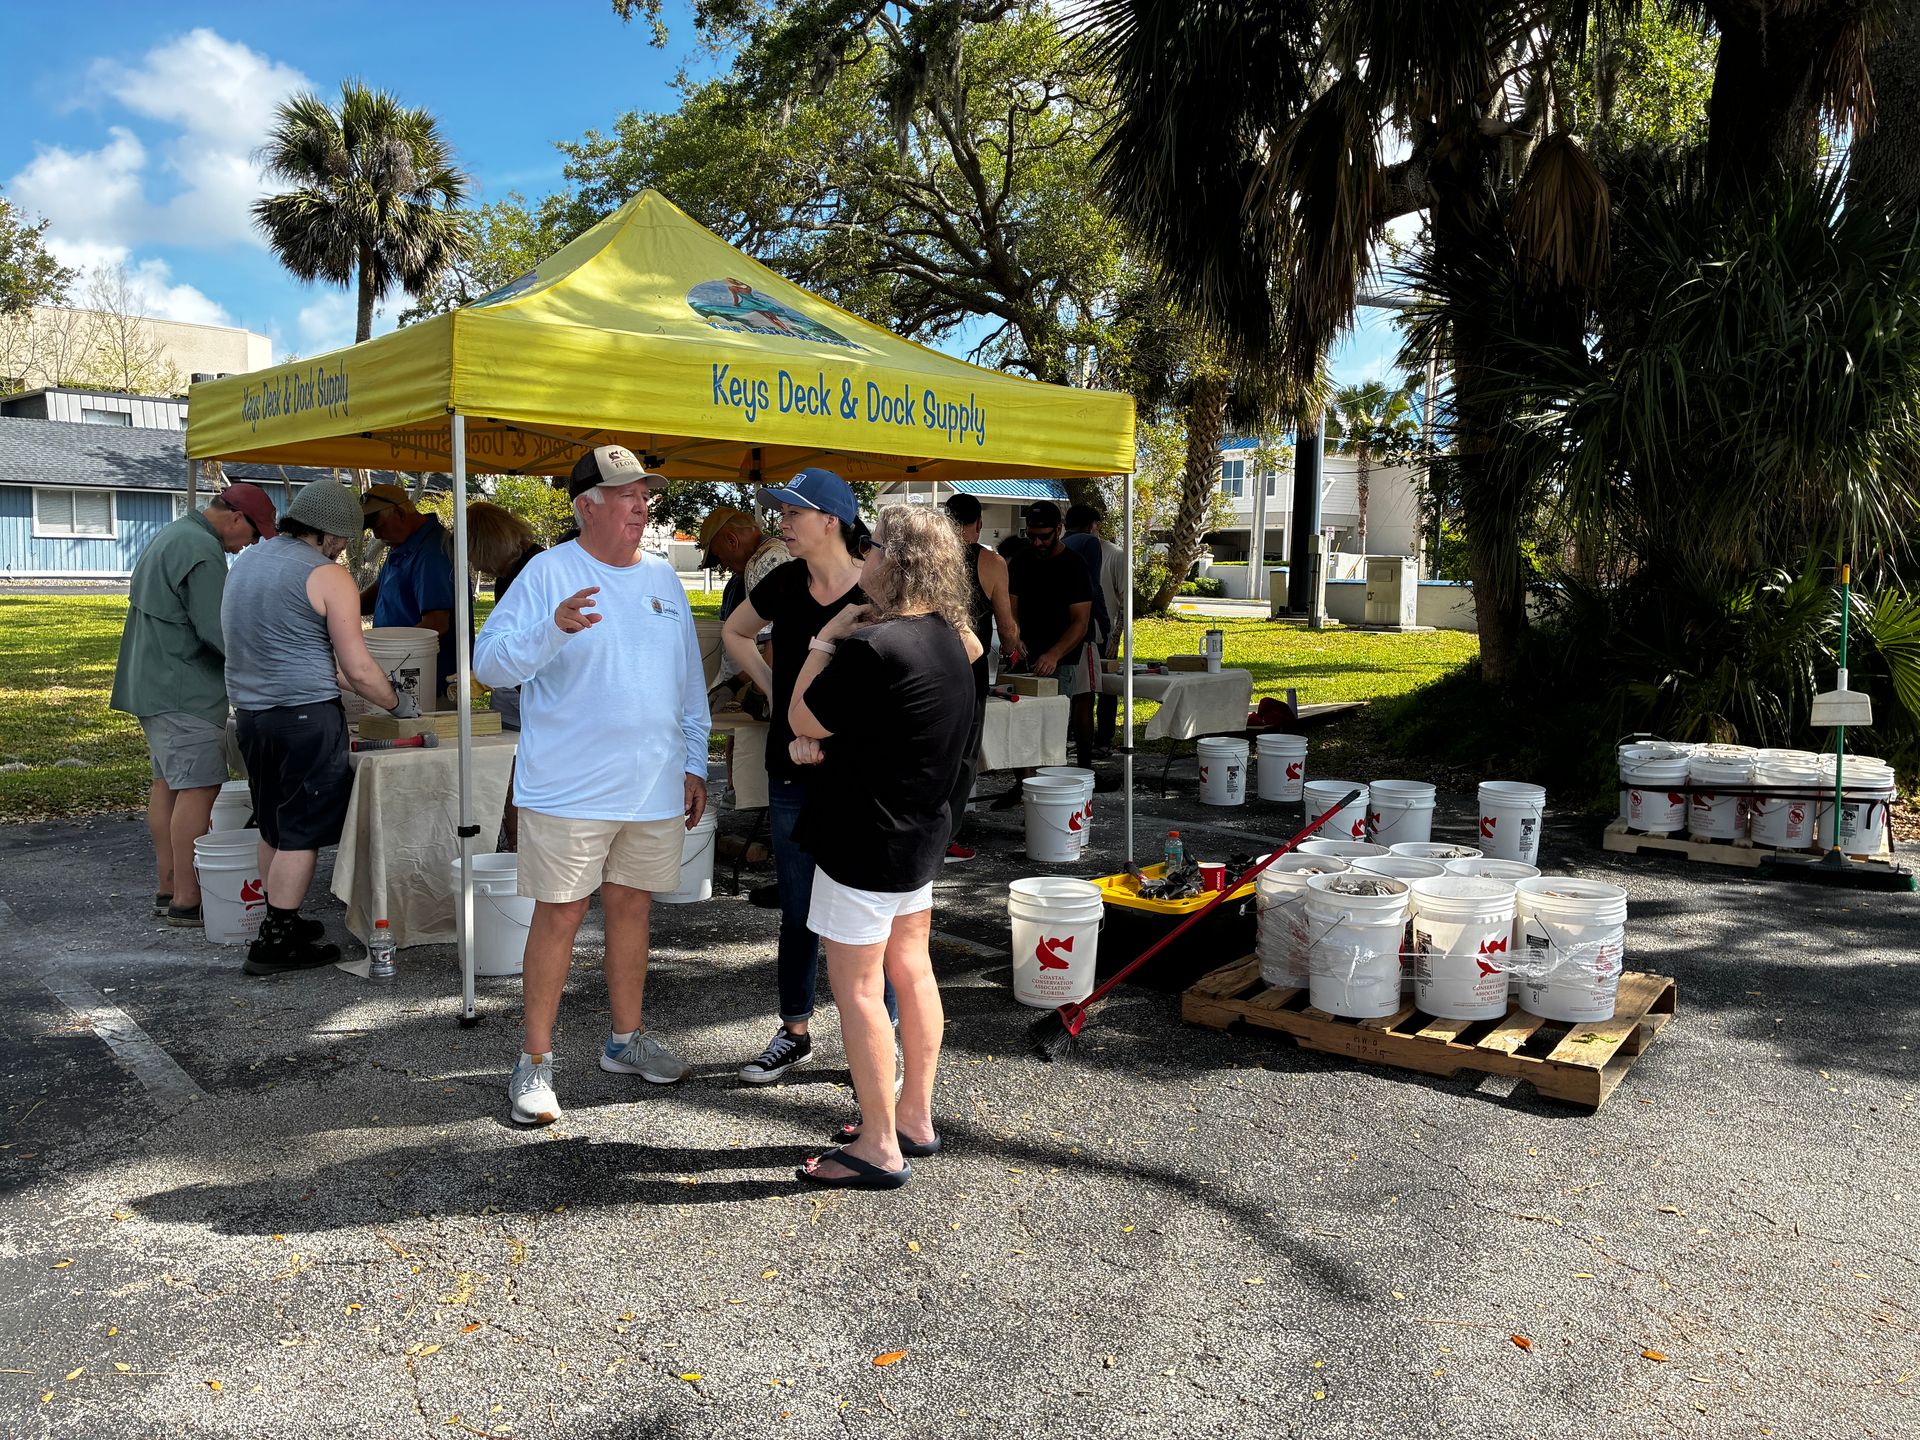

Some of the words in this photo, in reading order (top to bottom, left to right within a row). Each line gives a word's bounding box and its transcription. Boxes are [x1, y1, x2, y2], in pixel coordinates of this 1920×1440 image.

[242, 385, 261, 433] Keys
[262, 375, 281, 420] Deck
[283, 375, 291, 416] &
[293, 366, 315, 414] Dock
[317, 358, 349, 419] Supply
[711, 363, 769, 423] Keys
[778, 369, 831, 416] Deck
[839, 377, 859, 420] &
[866, 381, 916, 426] Dock
[923, 389, 986, 446] Supply
